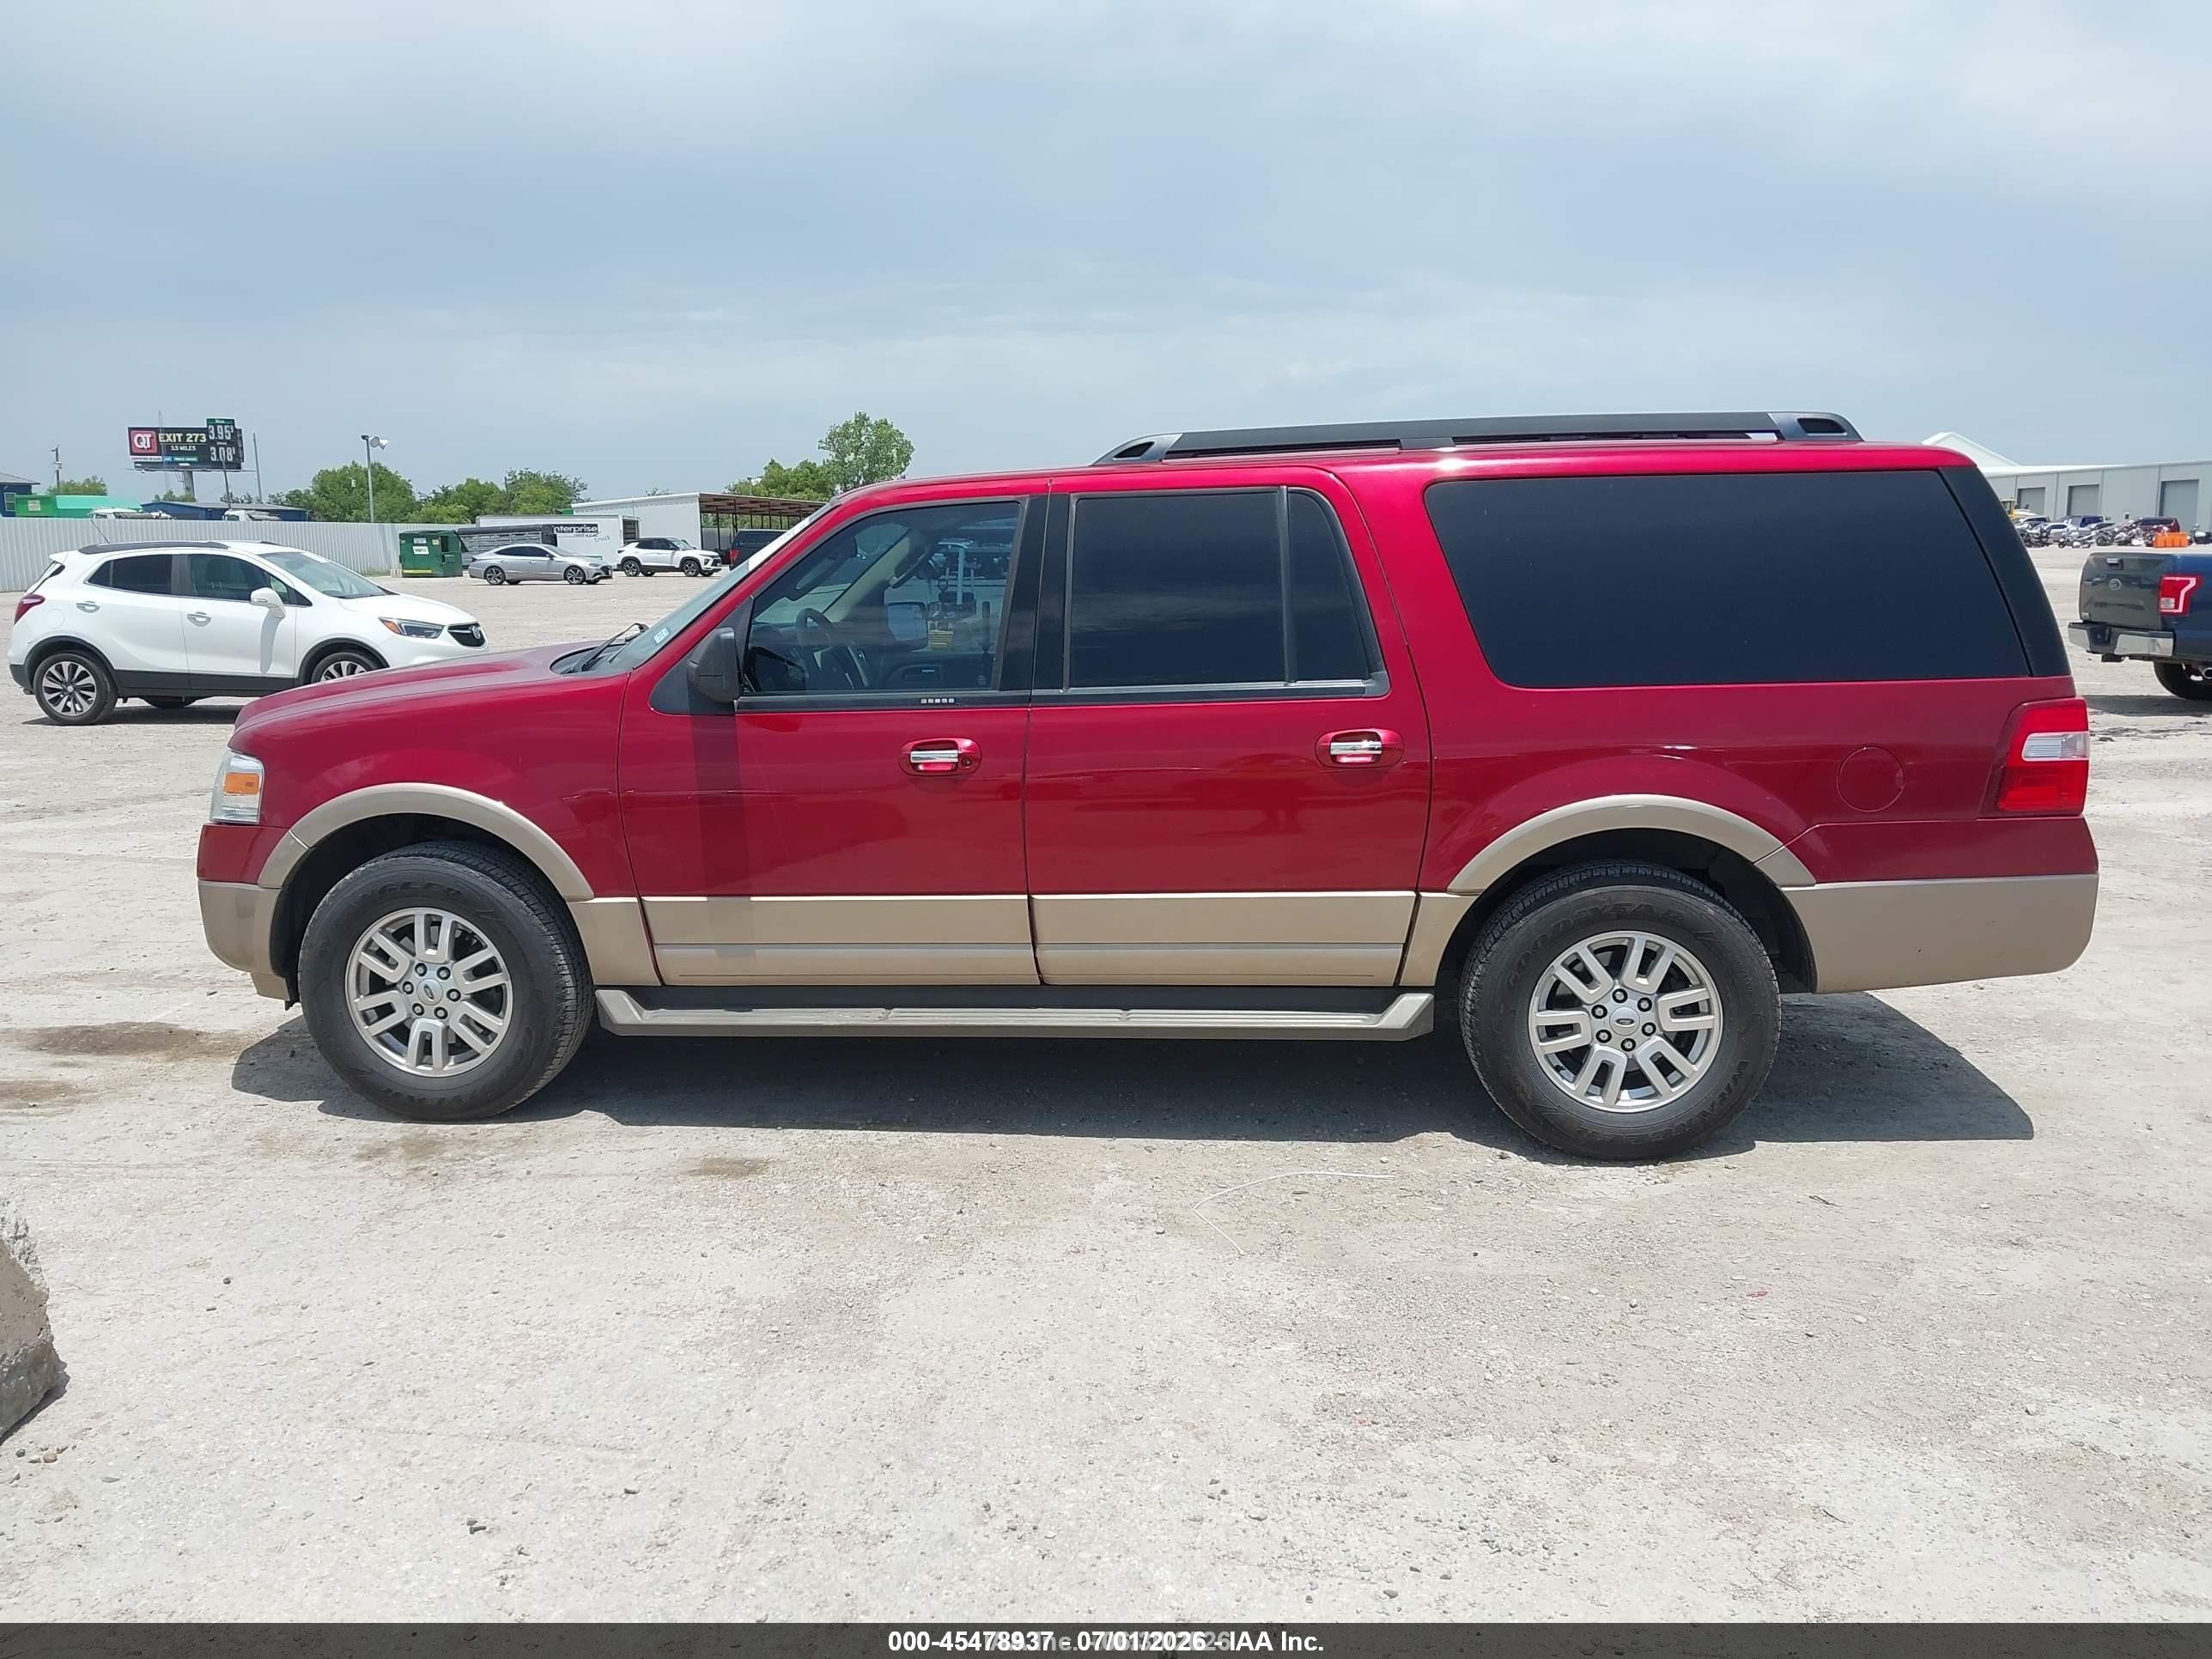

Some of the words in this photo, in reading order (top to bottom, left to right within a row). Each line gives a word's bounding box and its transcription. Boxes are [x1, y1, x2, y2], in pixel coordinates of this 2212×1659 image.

[158, 433, 183, 442] EXIT
[185, 433, 207, 442] 273
[209, 425, 231, 440] 3.95
[134, 434, 151, 449] QT
[210, 447, 233, 461] 3.08
[552, 524, 598, 534] nterprise
